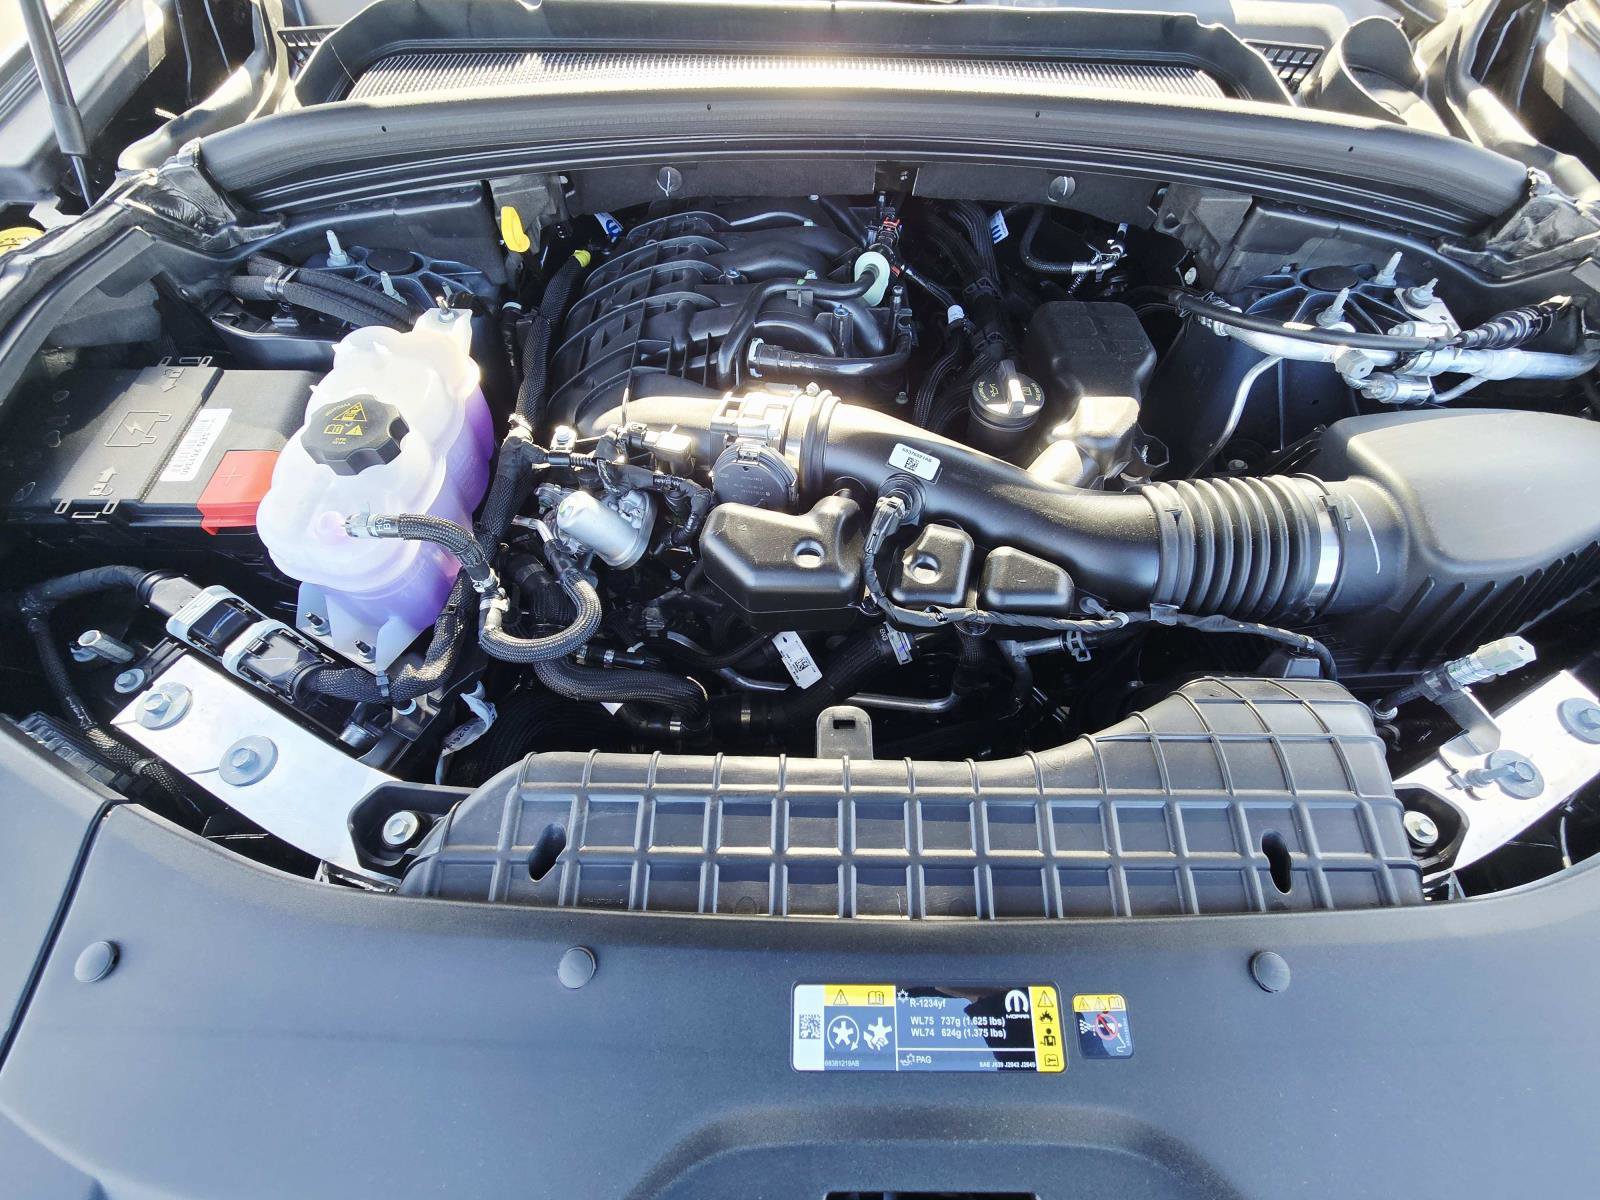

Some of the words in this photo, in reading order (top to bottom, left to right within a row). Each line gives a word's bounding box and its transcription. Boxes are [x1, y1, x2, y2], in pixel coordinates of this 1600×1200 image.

[909, 999, 946, 1011] R-1234yf
[910, 1016, 935, 1026] WL75
[940, 1016, 961, 1028] 737g
[962, 1016, 988, 1028] (1.625
[989, 1016, 1006, 1028] lbs)
[911, 1028, 935, 1038] WL74
[941, 1028, 962, 1040] 624g
[963, 1028, 989, 1040] (1.375
[990, 1028, 1007, 1040] lbs)
[916, 1055, 932, 1064] PAG
